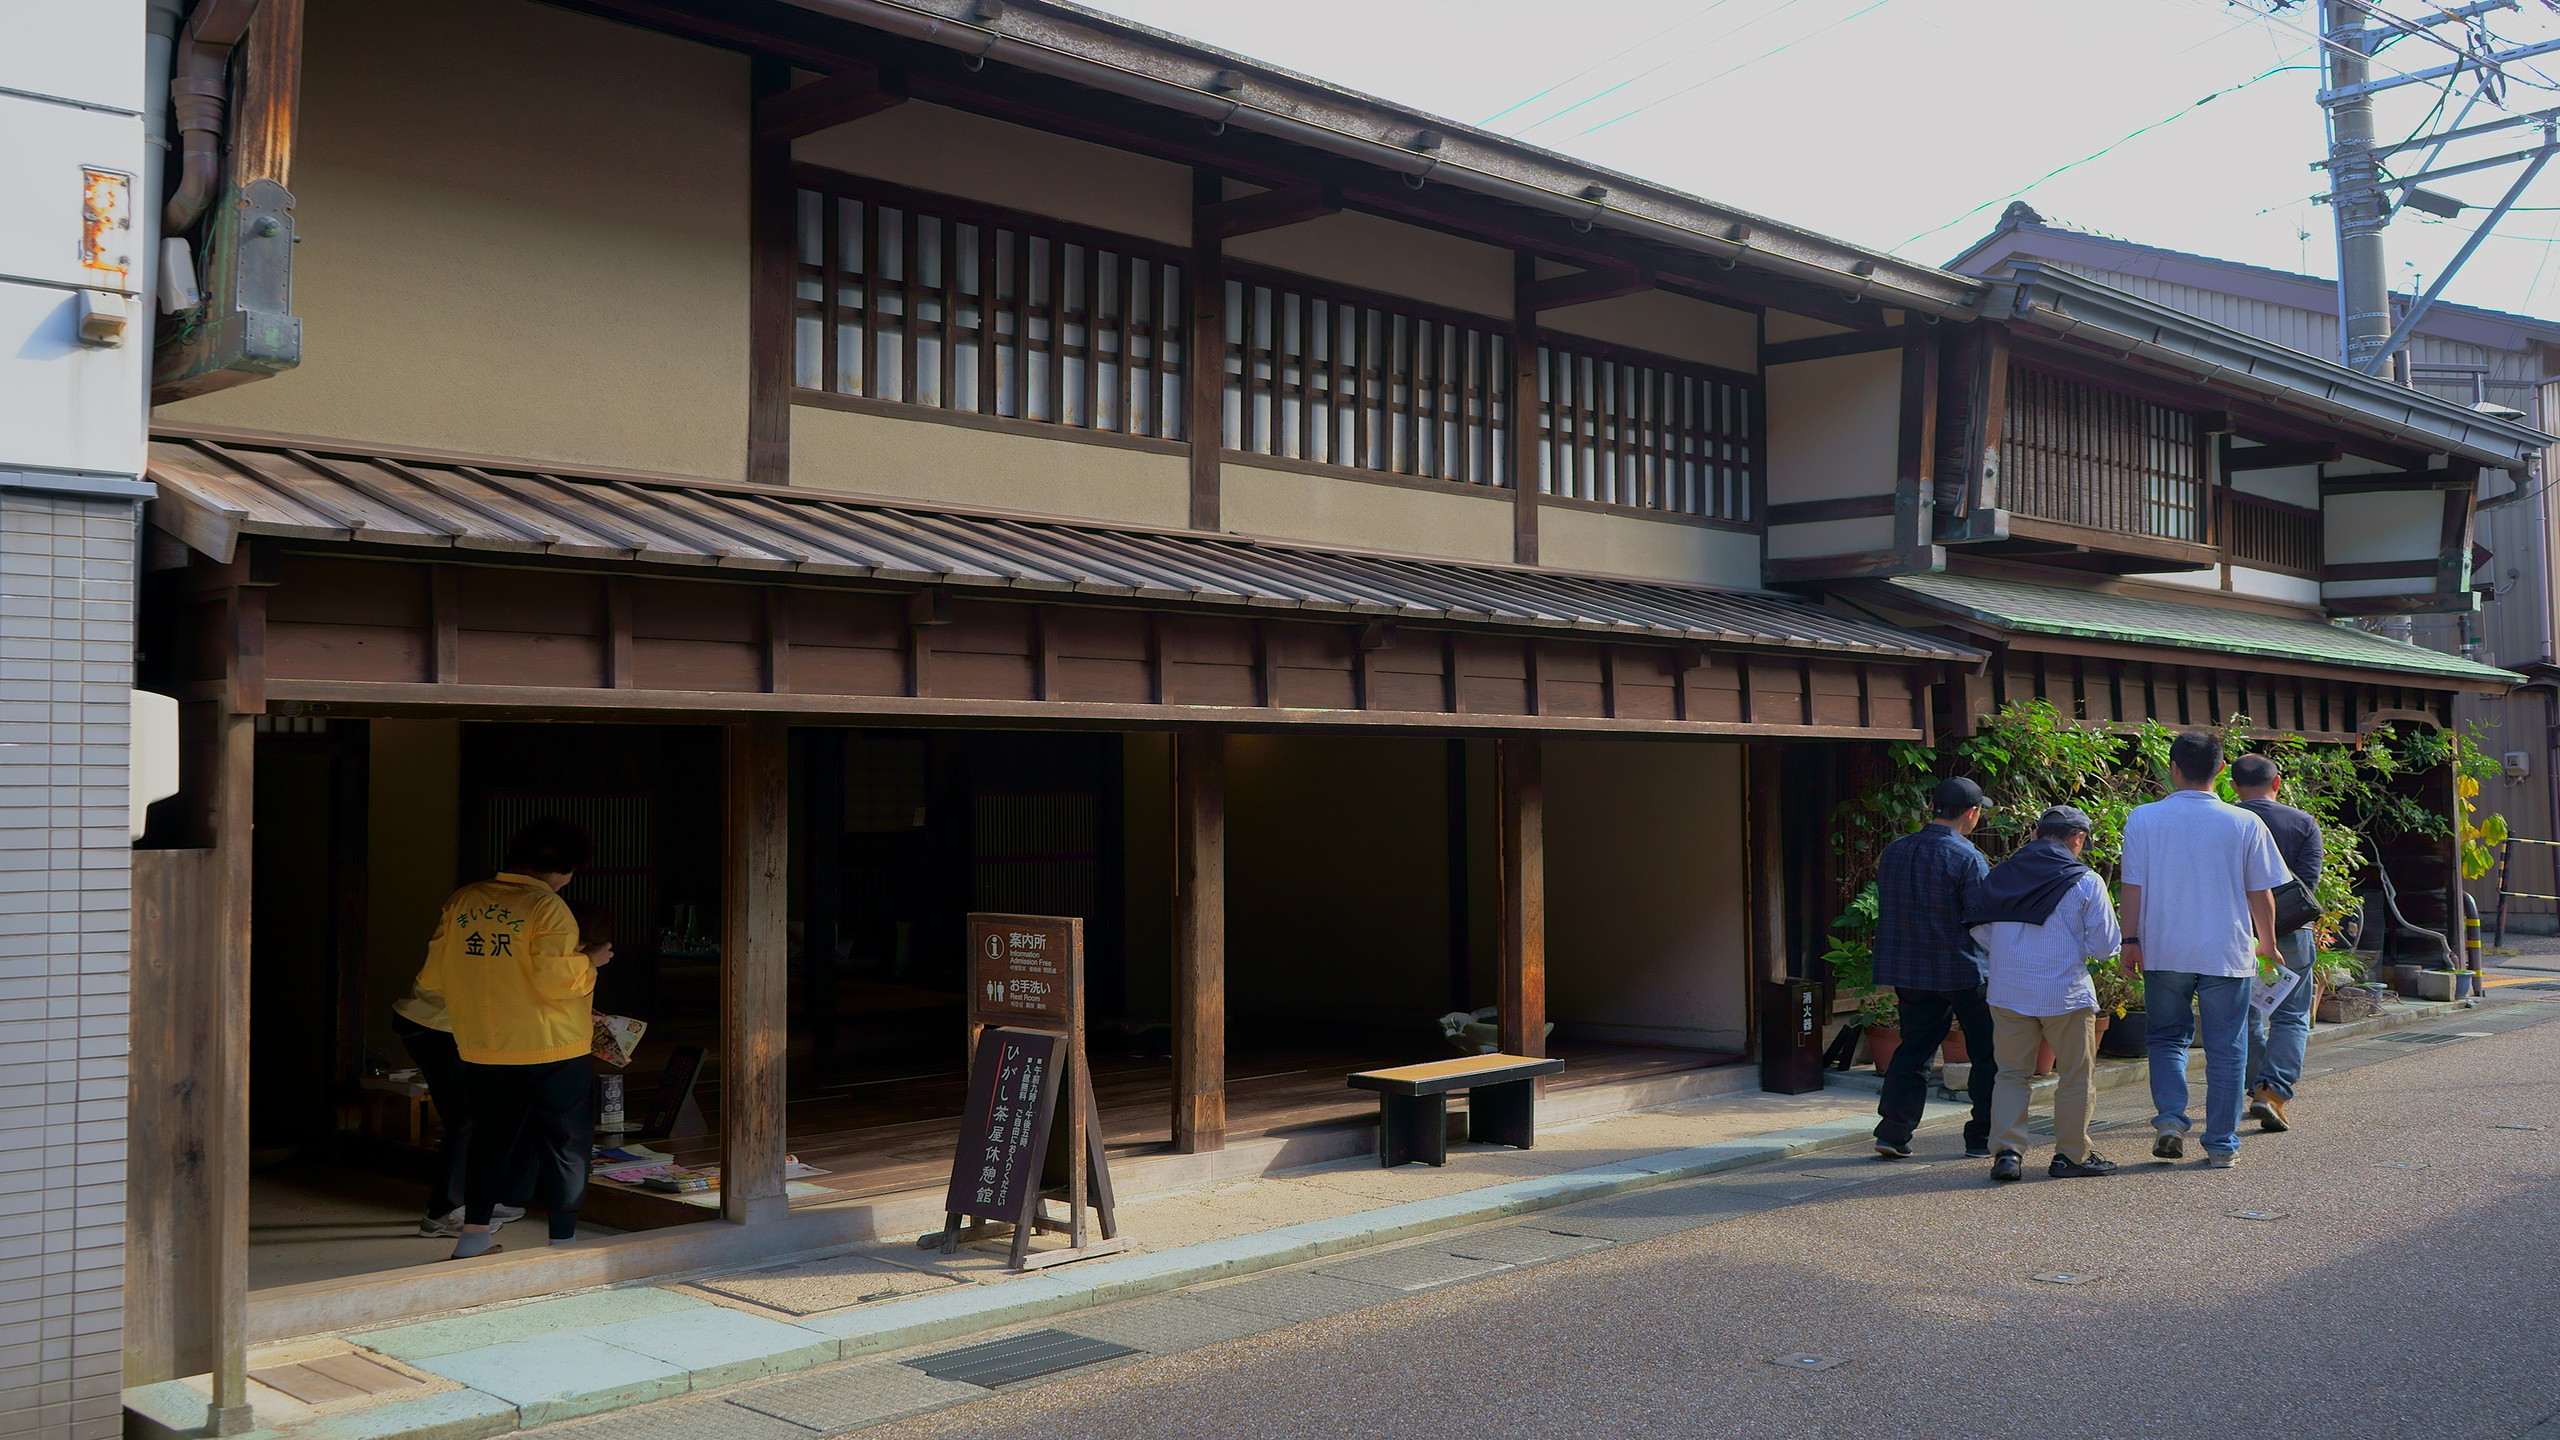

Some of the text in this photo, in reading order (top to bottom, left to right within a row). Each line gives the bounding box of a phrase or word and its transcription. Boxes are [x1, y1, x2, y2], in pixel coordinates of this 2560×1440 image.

[456, 903, 525, 932] まいどさん
[465, 931, 512, 957] 金沢
[1010, 932, 1046, 950] 案内所
[1010, 950, 1040, 958] Information
[1010, 958, 1052, 967] Admission Free
[1010, 979, 1051, 994] お手洗い
[1024, 994, 1041, 1002] Room
[1802, 991, 1813, 1032] 消火器
[976, 1045, 1020, 1205] ひがし茶屋休憩館
[997, 1109, 1025, 1207] ご自由にお入りください
